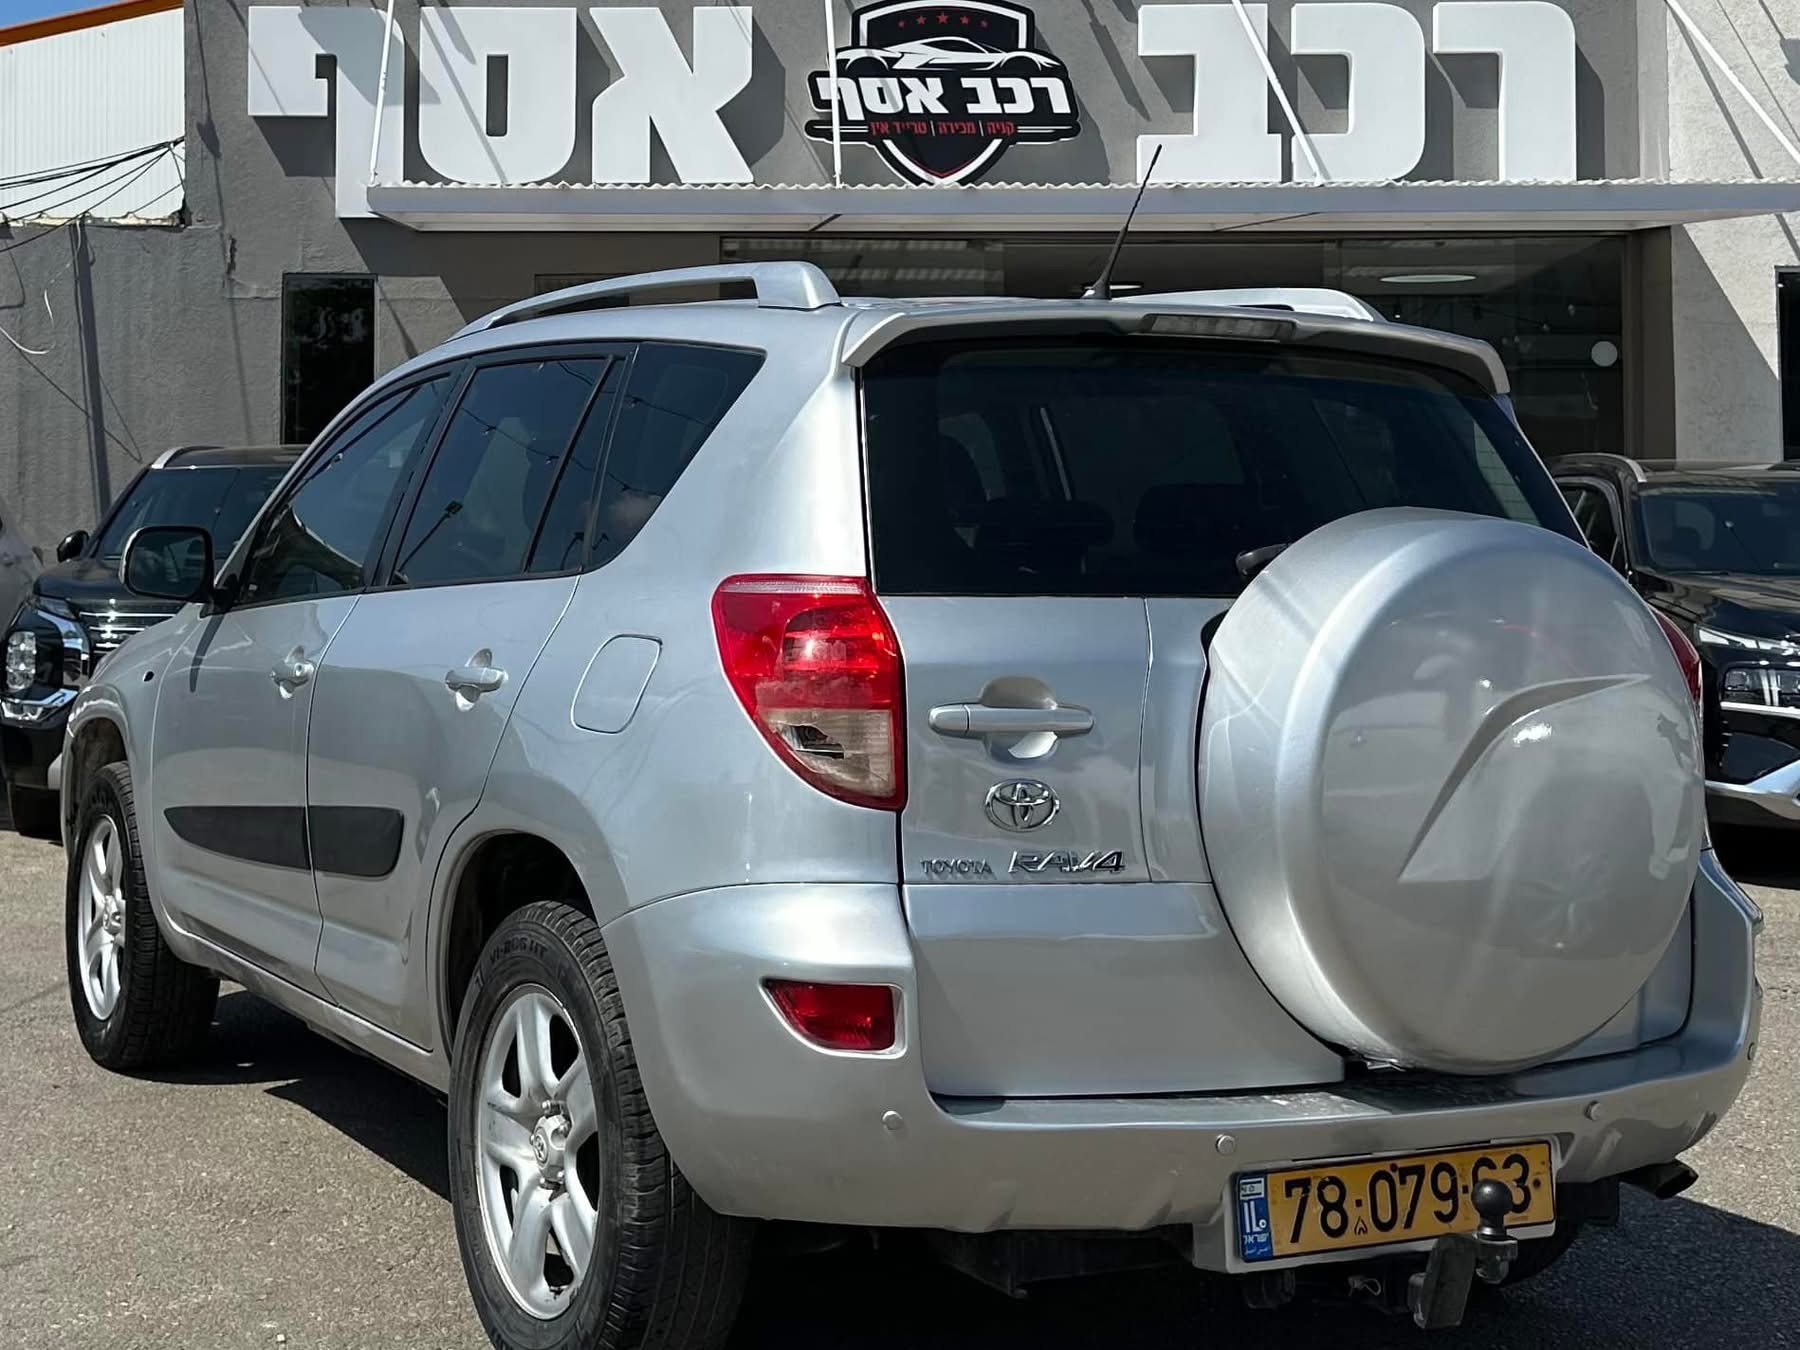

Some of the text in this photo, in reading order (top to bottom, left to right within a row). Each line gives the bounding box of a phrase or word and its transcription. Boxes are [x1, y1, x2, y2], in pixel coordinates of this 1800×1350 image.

[816, 77, 1071, 120] רכב אסף
[248, 1, 1576, 217] רכב אסף
[869, 121, 890, 135] אין
[892, 121, 927, 134] טרייד
[937, 121, 976, 134] מכירה
[921, 851, 1126, 874] TOYOTA RAV4
